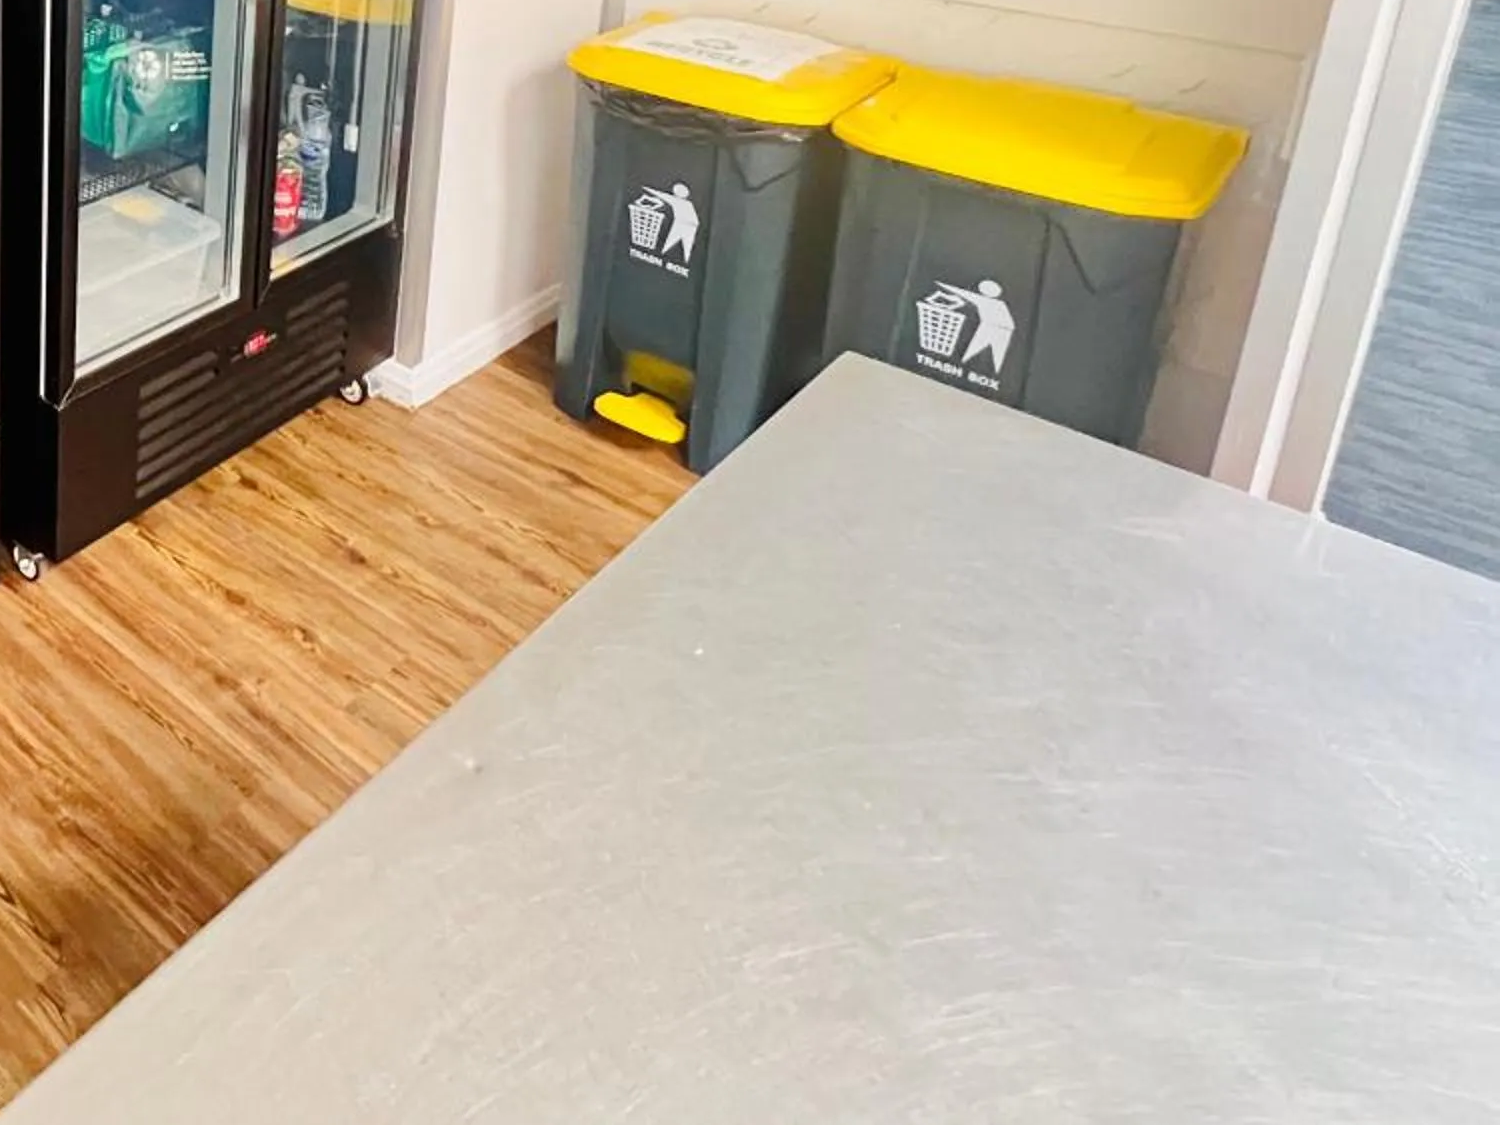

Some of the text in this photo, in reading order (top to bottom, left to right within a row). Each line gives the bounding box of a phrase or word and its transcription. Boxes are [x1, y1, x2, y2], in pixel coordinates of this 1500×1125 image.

[629, 248, 690, 279] TRASH BOX
[915, 352, 1000, 391] TRASH BOX
